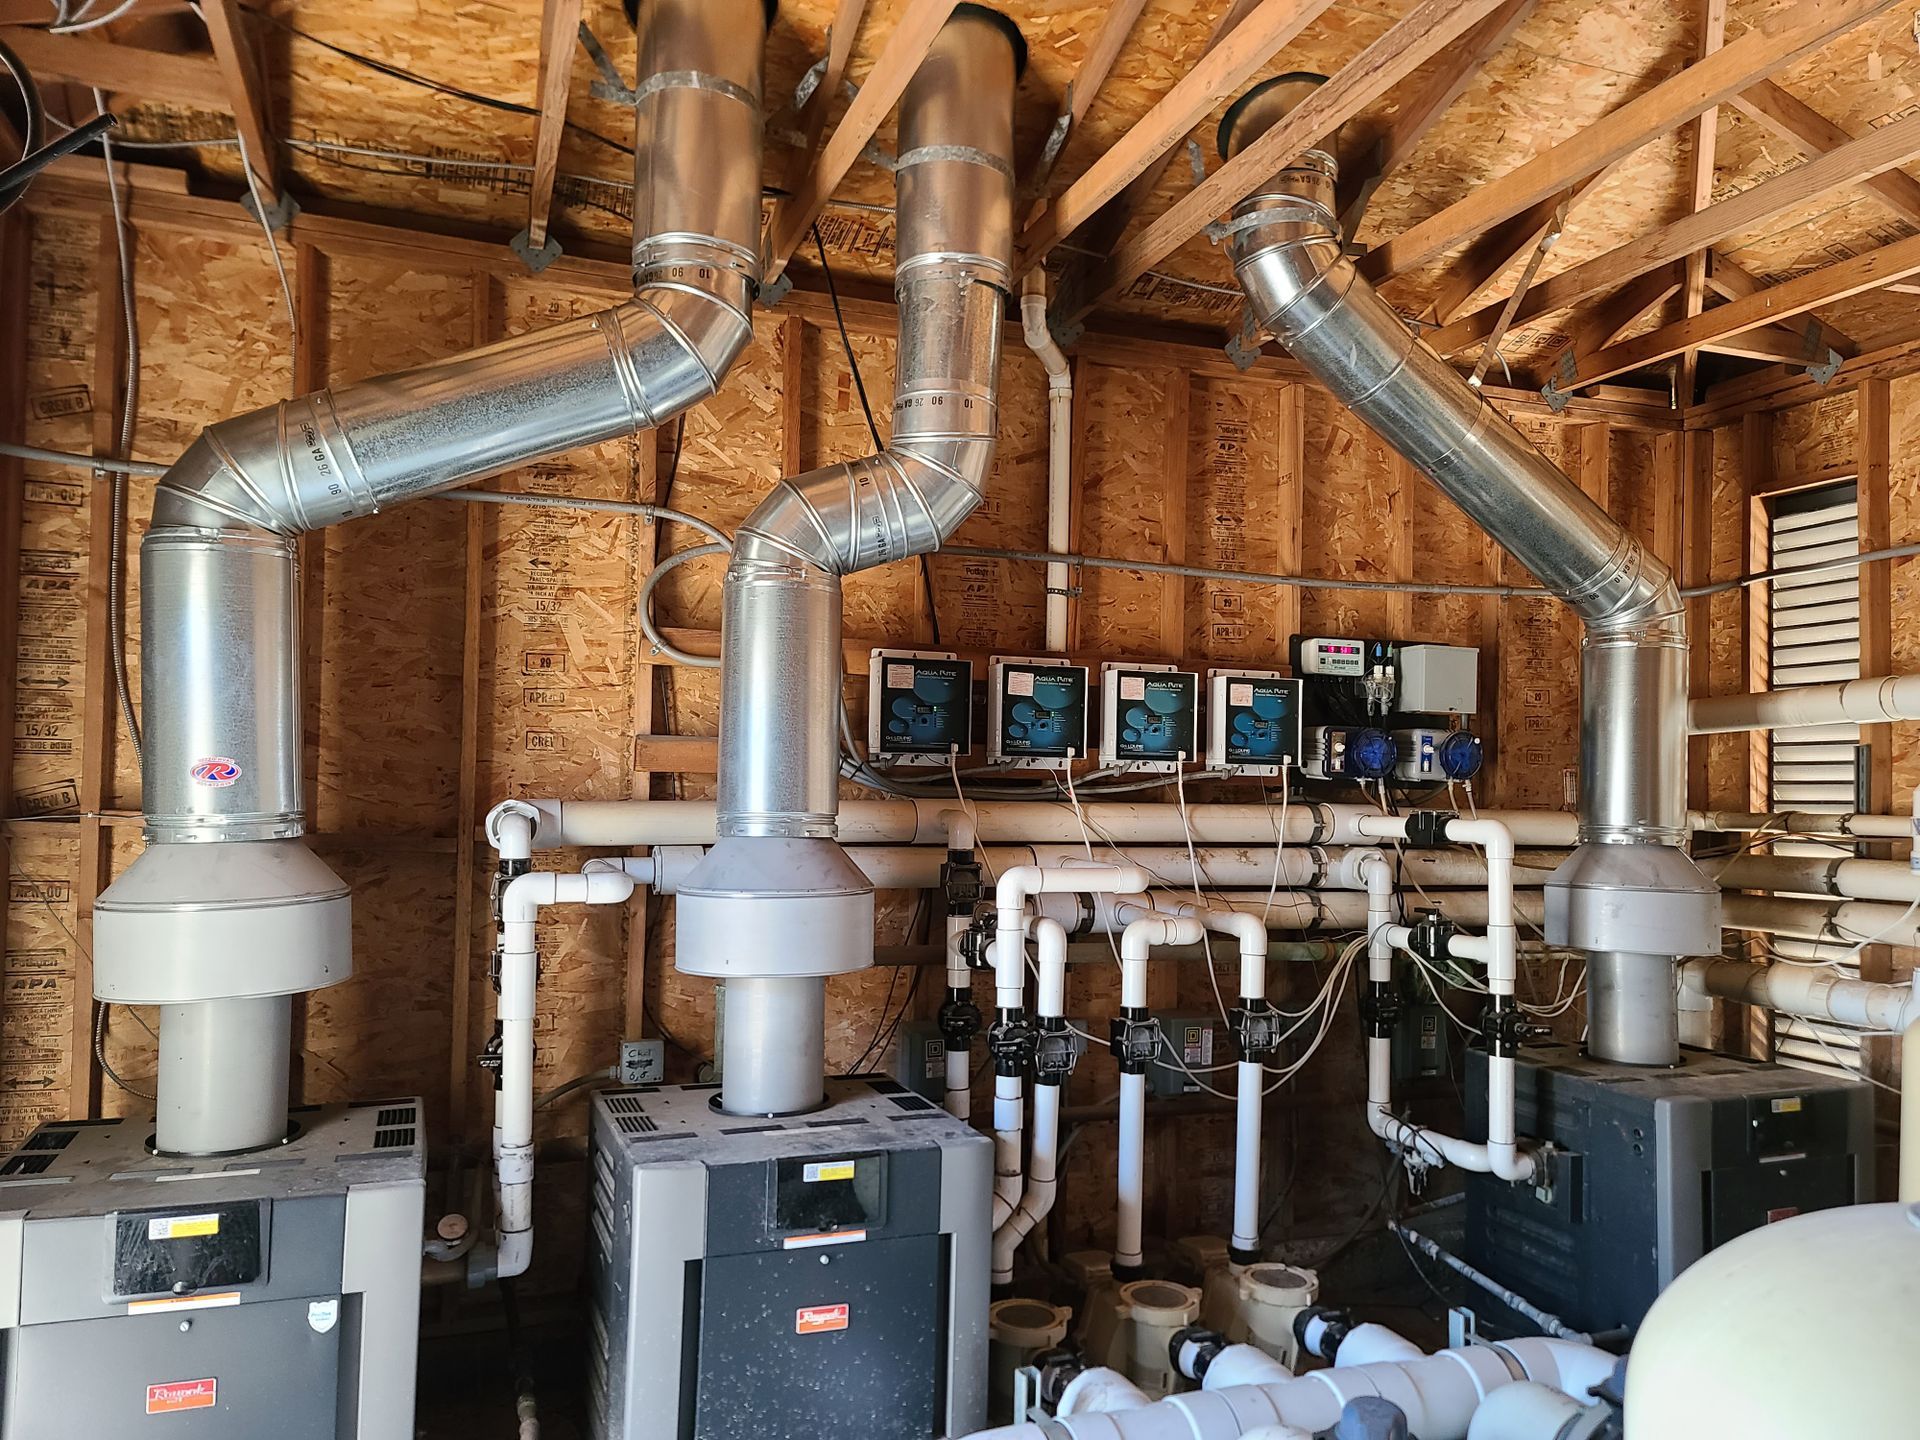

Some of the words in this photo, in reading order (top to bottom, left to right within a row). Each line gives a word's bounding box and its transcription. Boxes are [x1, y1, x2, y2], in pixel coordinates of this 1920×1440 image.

[672, 267, 684, 278] 90
[699, 268, 710, 279] 10
[931, 396, 944, 406] 90
[964, 398, 974, 409] 10
[312, 447, 326, 462] GA
[318, 463, 331, 477] 26
[859, 477, 870, 487] 10
[328, 483, 342, 496] 90
[535, 601, 562, 612] 15/32
[25, 724, 59, 737] 15/32
[62, 791, 71, 804] B
[12, 979, 57, 990] APA
